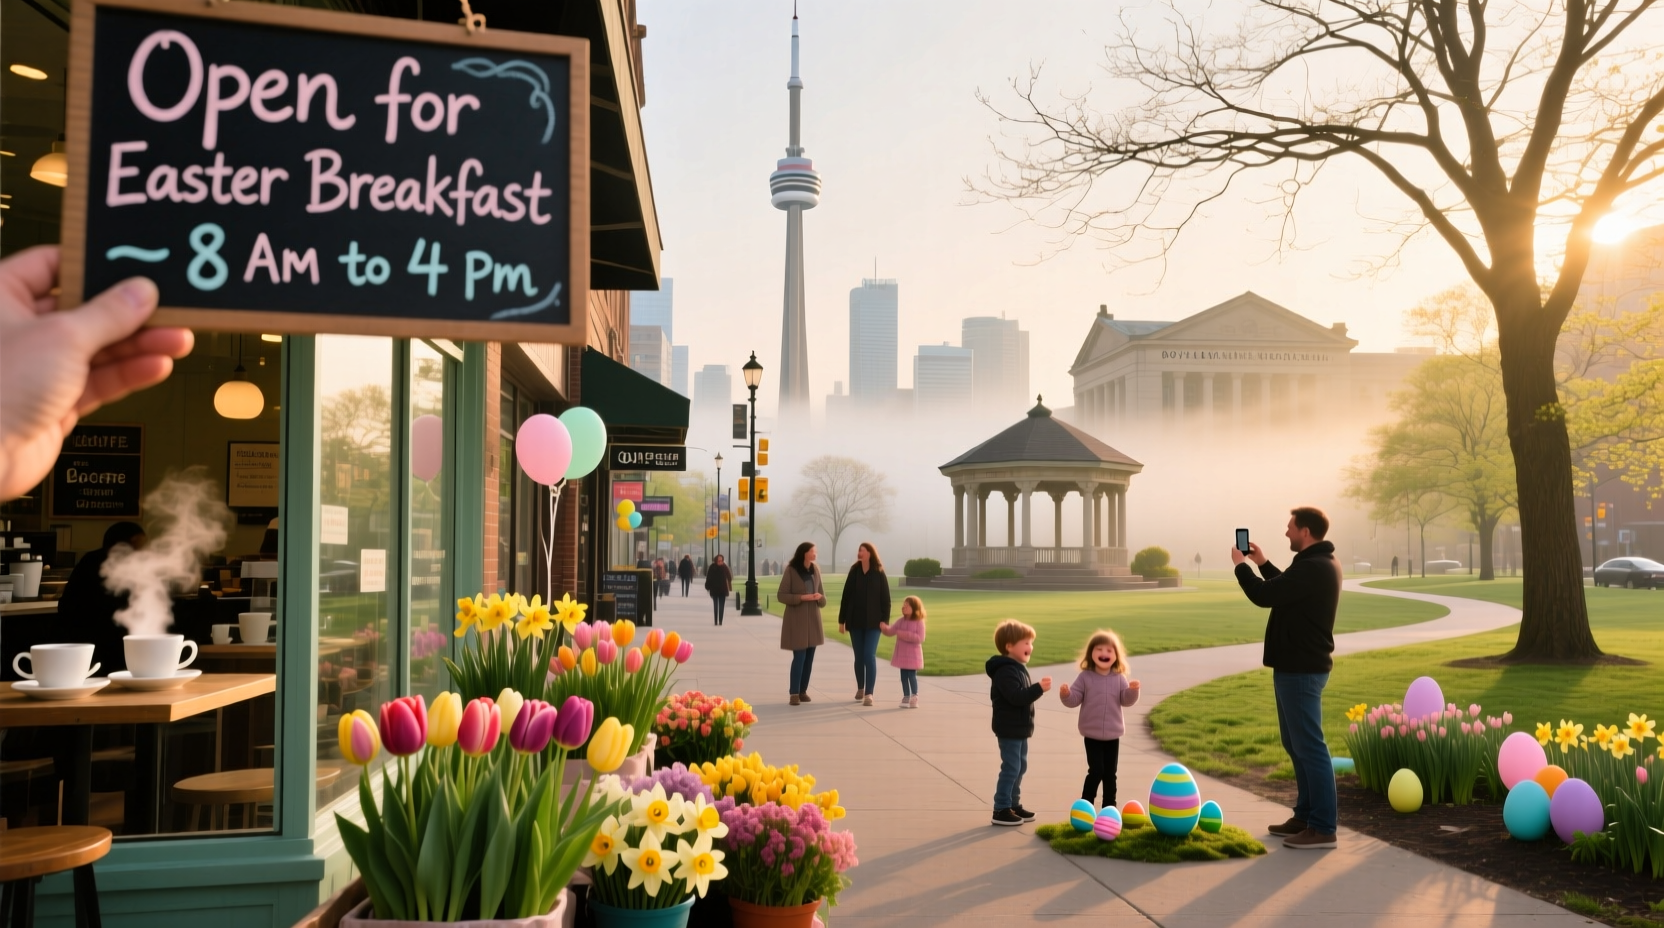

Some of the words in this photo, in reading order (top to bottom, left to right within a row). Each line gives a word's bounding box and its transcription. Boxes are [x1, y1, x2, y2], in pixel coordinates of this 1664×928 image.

[127, 29, 357, 151] Open
[374, 56, 481, 144] for
[106, 140, 289, 207] Easter
[304, 148, 553, 226] Breakfast
[187, 222, 229, 291] 8
[338, 240, 391, 286] to
[407, 237, 449, 296] 4
